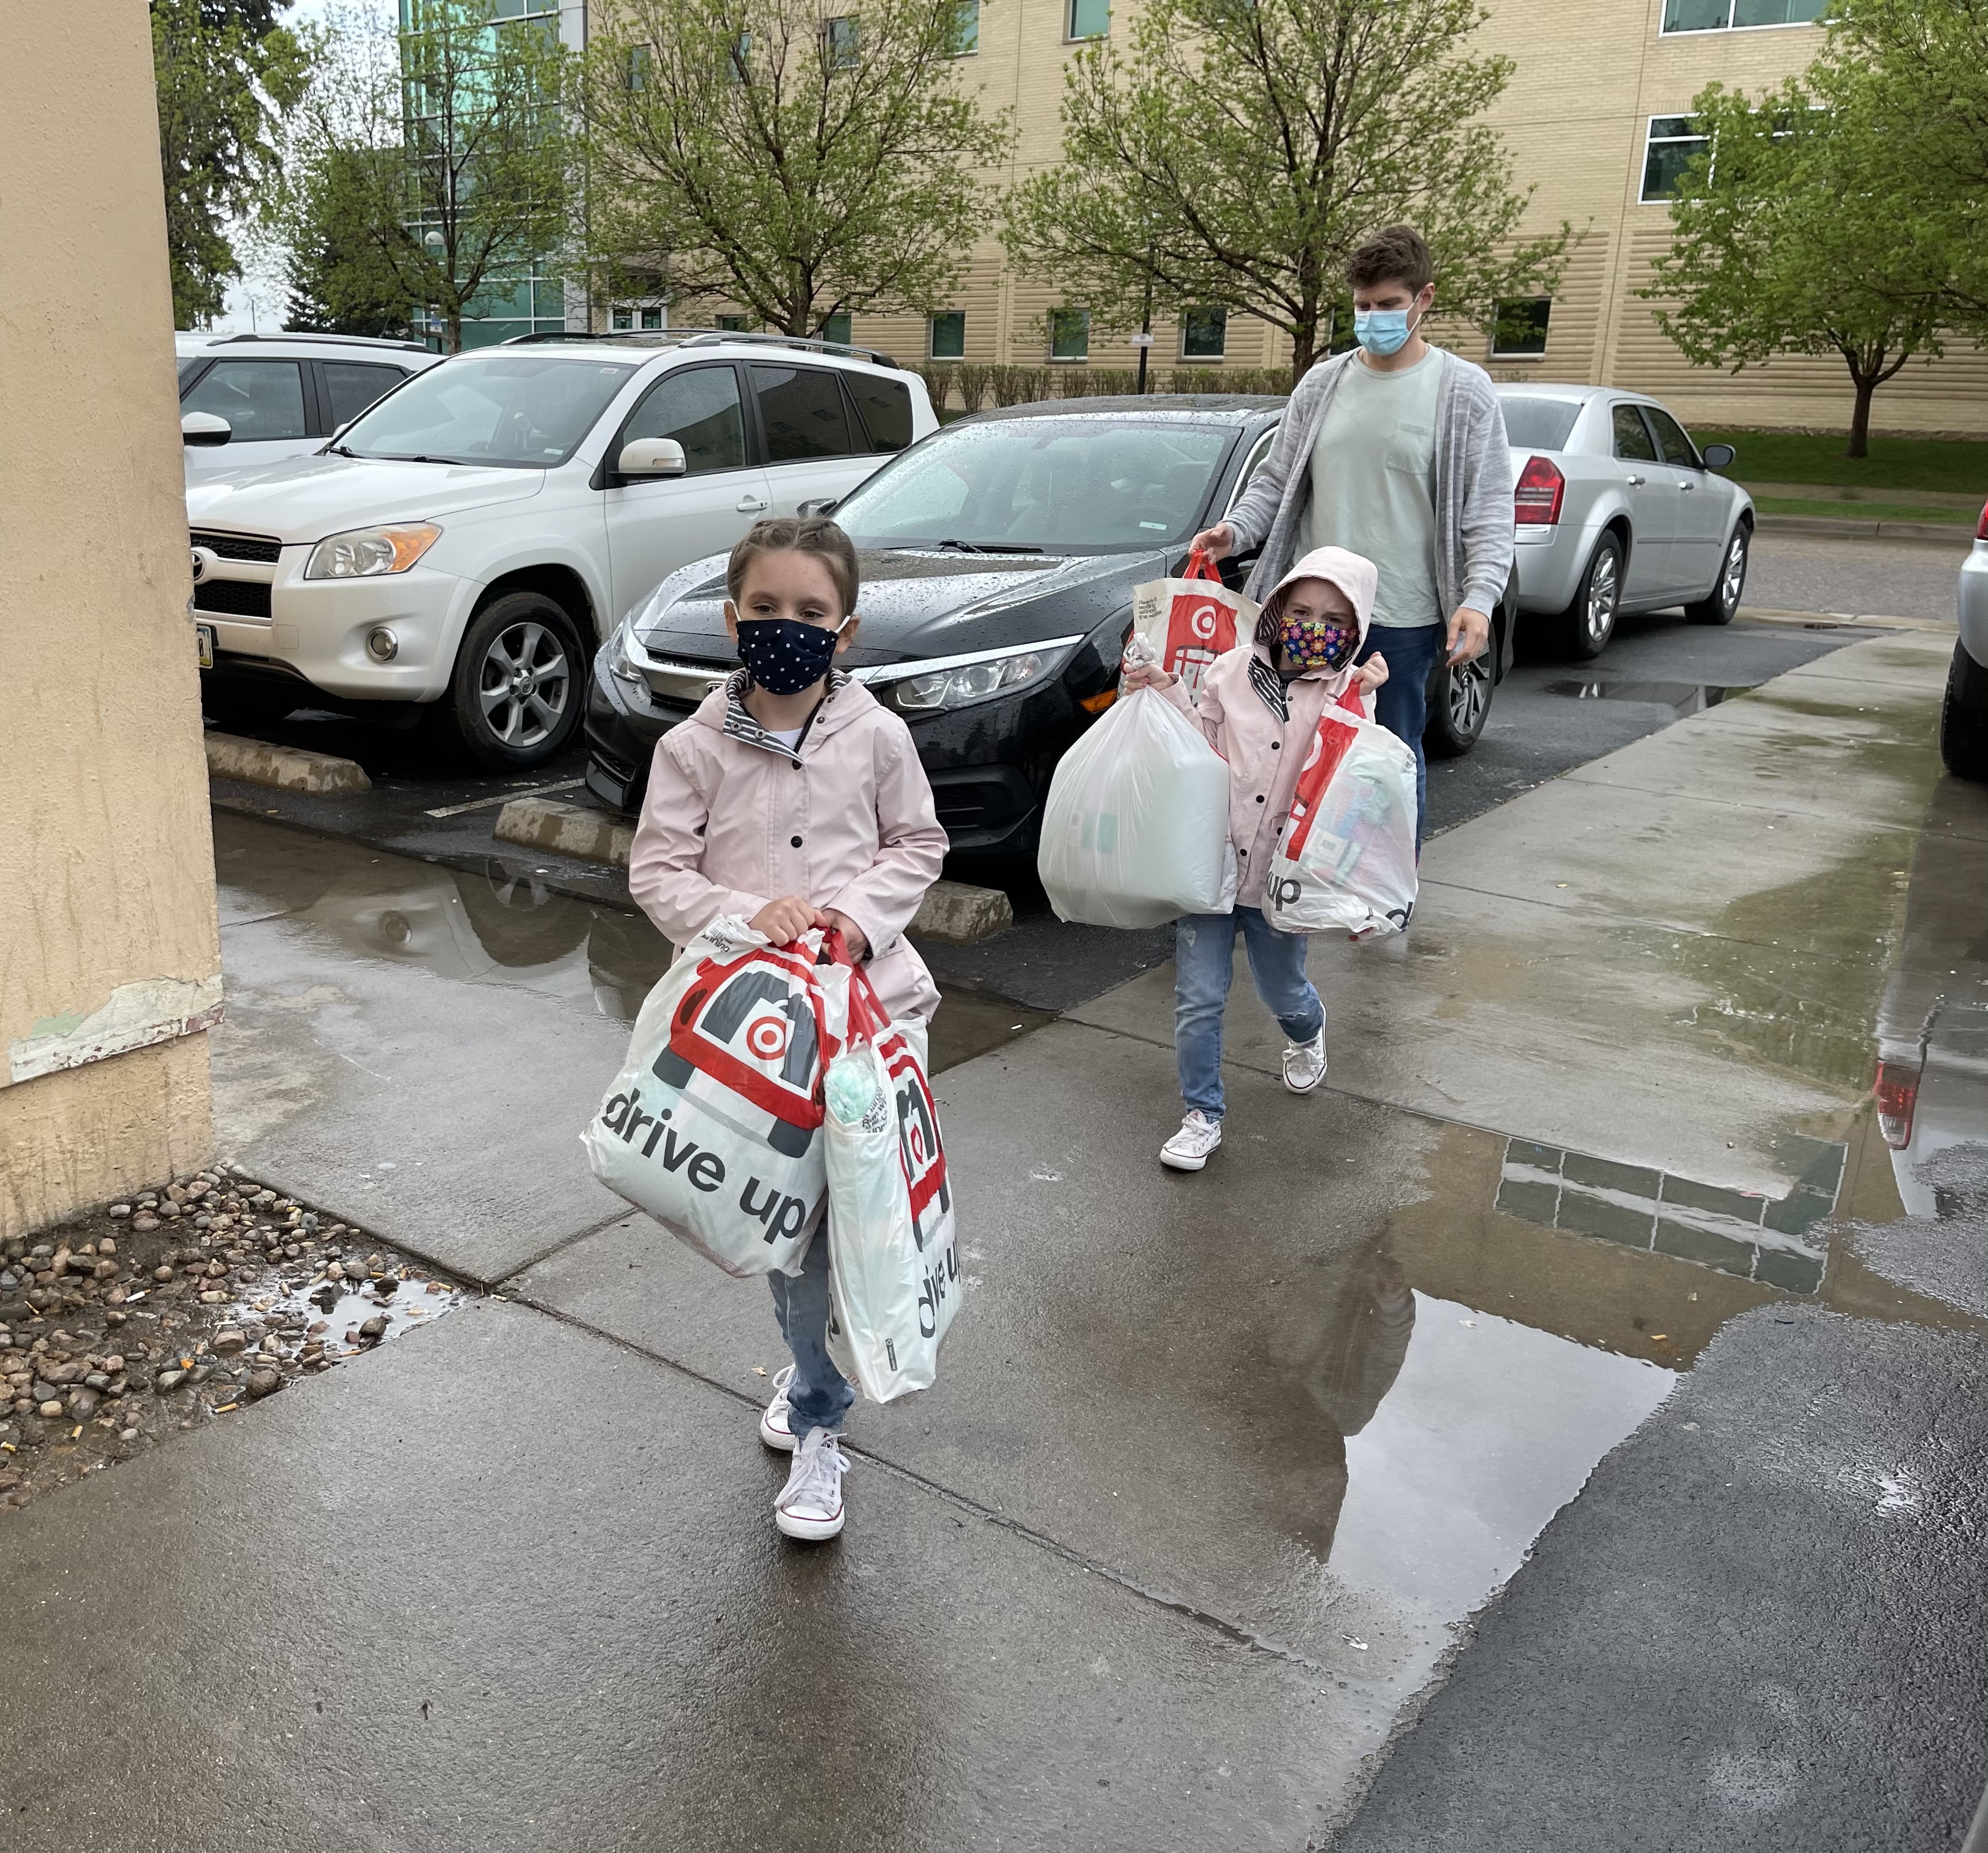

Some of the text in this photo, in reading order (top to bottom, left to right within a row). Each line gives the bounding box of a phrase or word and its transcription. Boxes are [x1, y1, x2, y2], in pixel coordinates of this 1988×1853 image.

[1267, 871, 1301, 912] up
[601, 1087, 806, 1245] drive up
